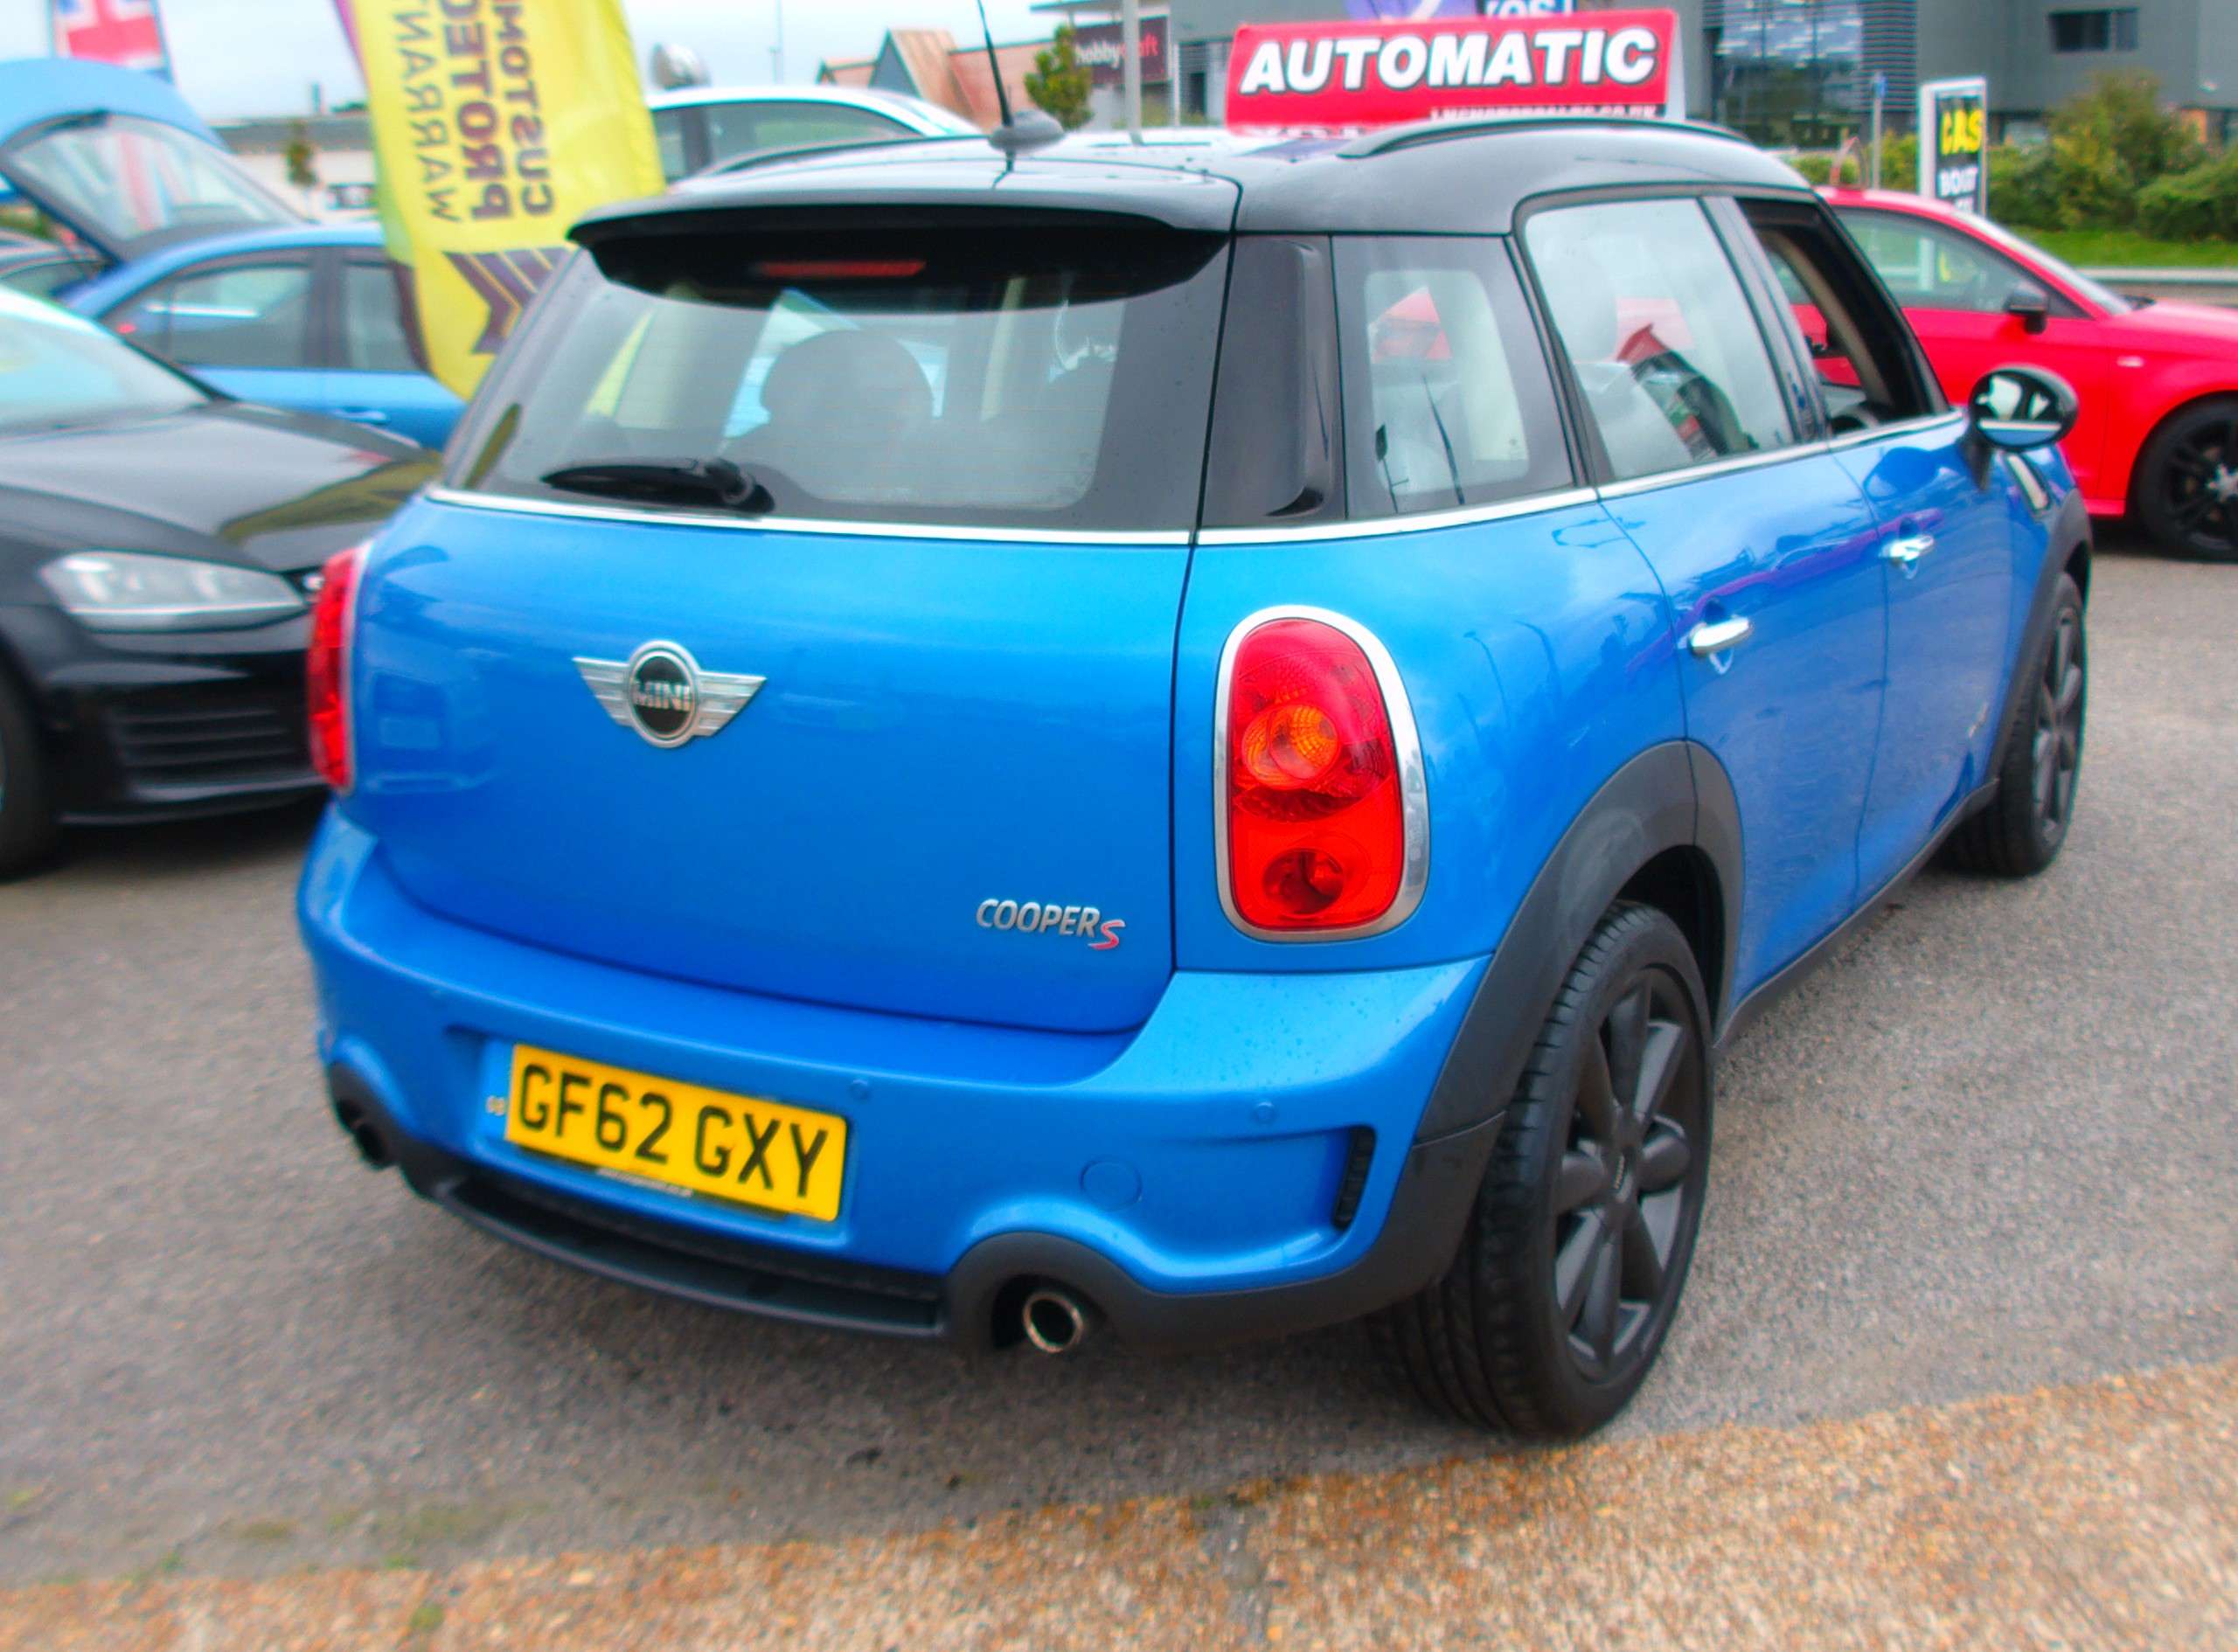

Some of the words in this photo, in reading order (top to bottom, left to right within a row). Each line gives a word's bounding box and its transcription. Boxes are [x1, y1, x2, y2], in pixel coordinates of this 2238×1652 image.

[1238, 27, 1658, 94] AUTOMATIC
[976, 898, 1100, 938] COOPER
[1087, 920, 1126, 951] S
[519, 1063, 674, 1165] GF62
[694, 1104, 829, 1199] GXY
